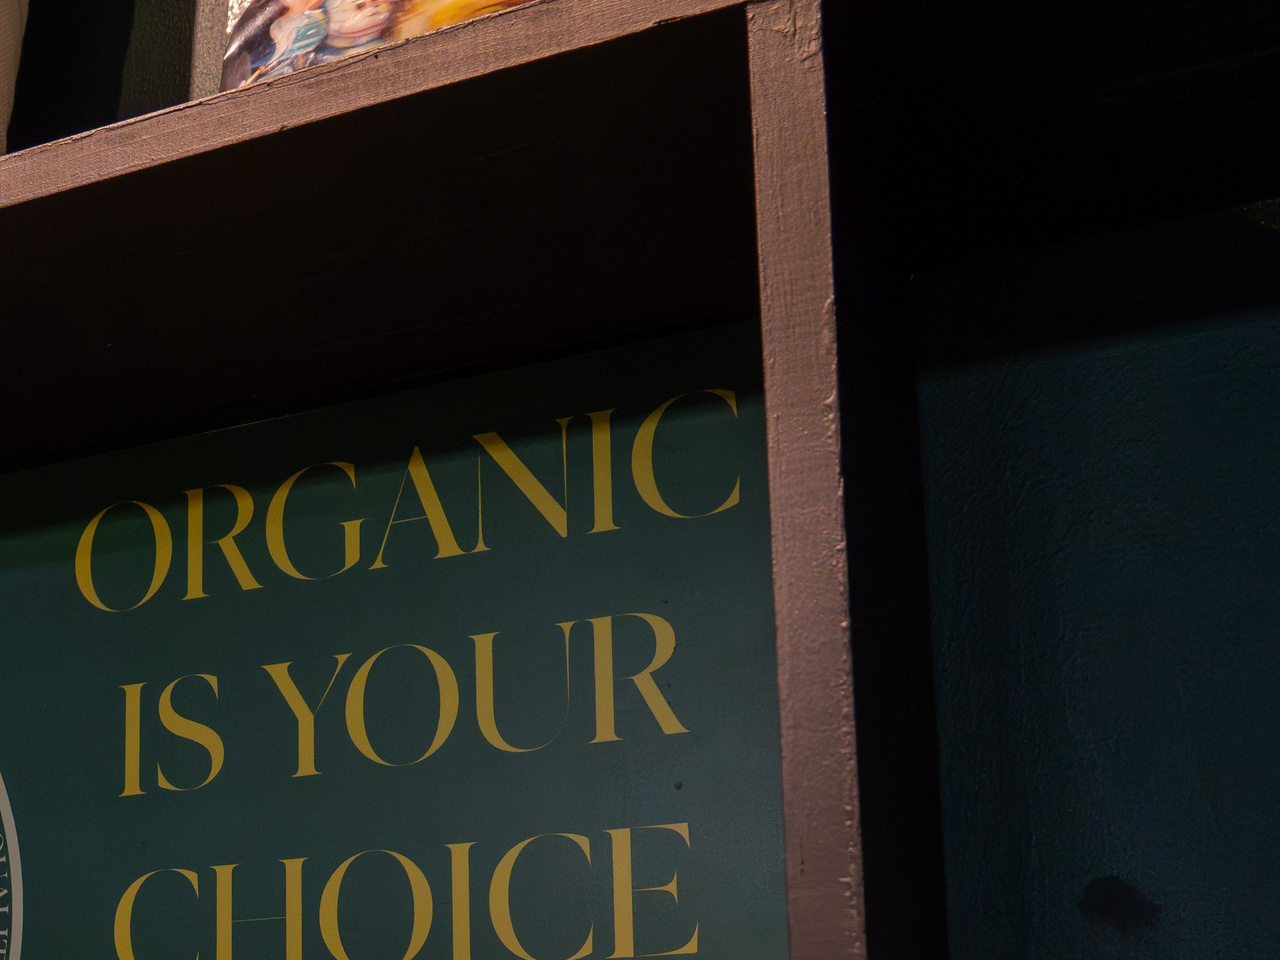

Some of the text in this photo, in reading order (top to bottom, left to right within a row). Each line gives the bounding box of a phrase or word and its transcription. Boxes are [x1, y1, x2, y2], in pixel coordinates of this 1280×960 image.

[74, 388, 741, 612] ORGANIC
[118, 612, 691, 798] IS YOUR
